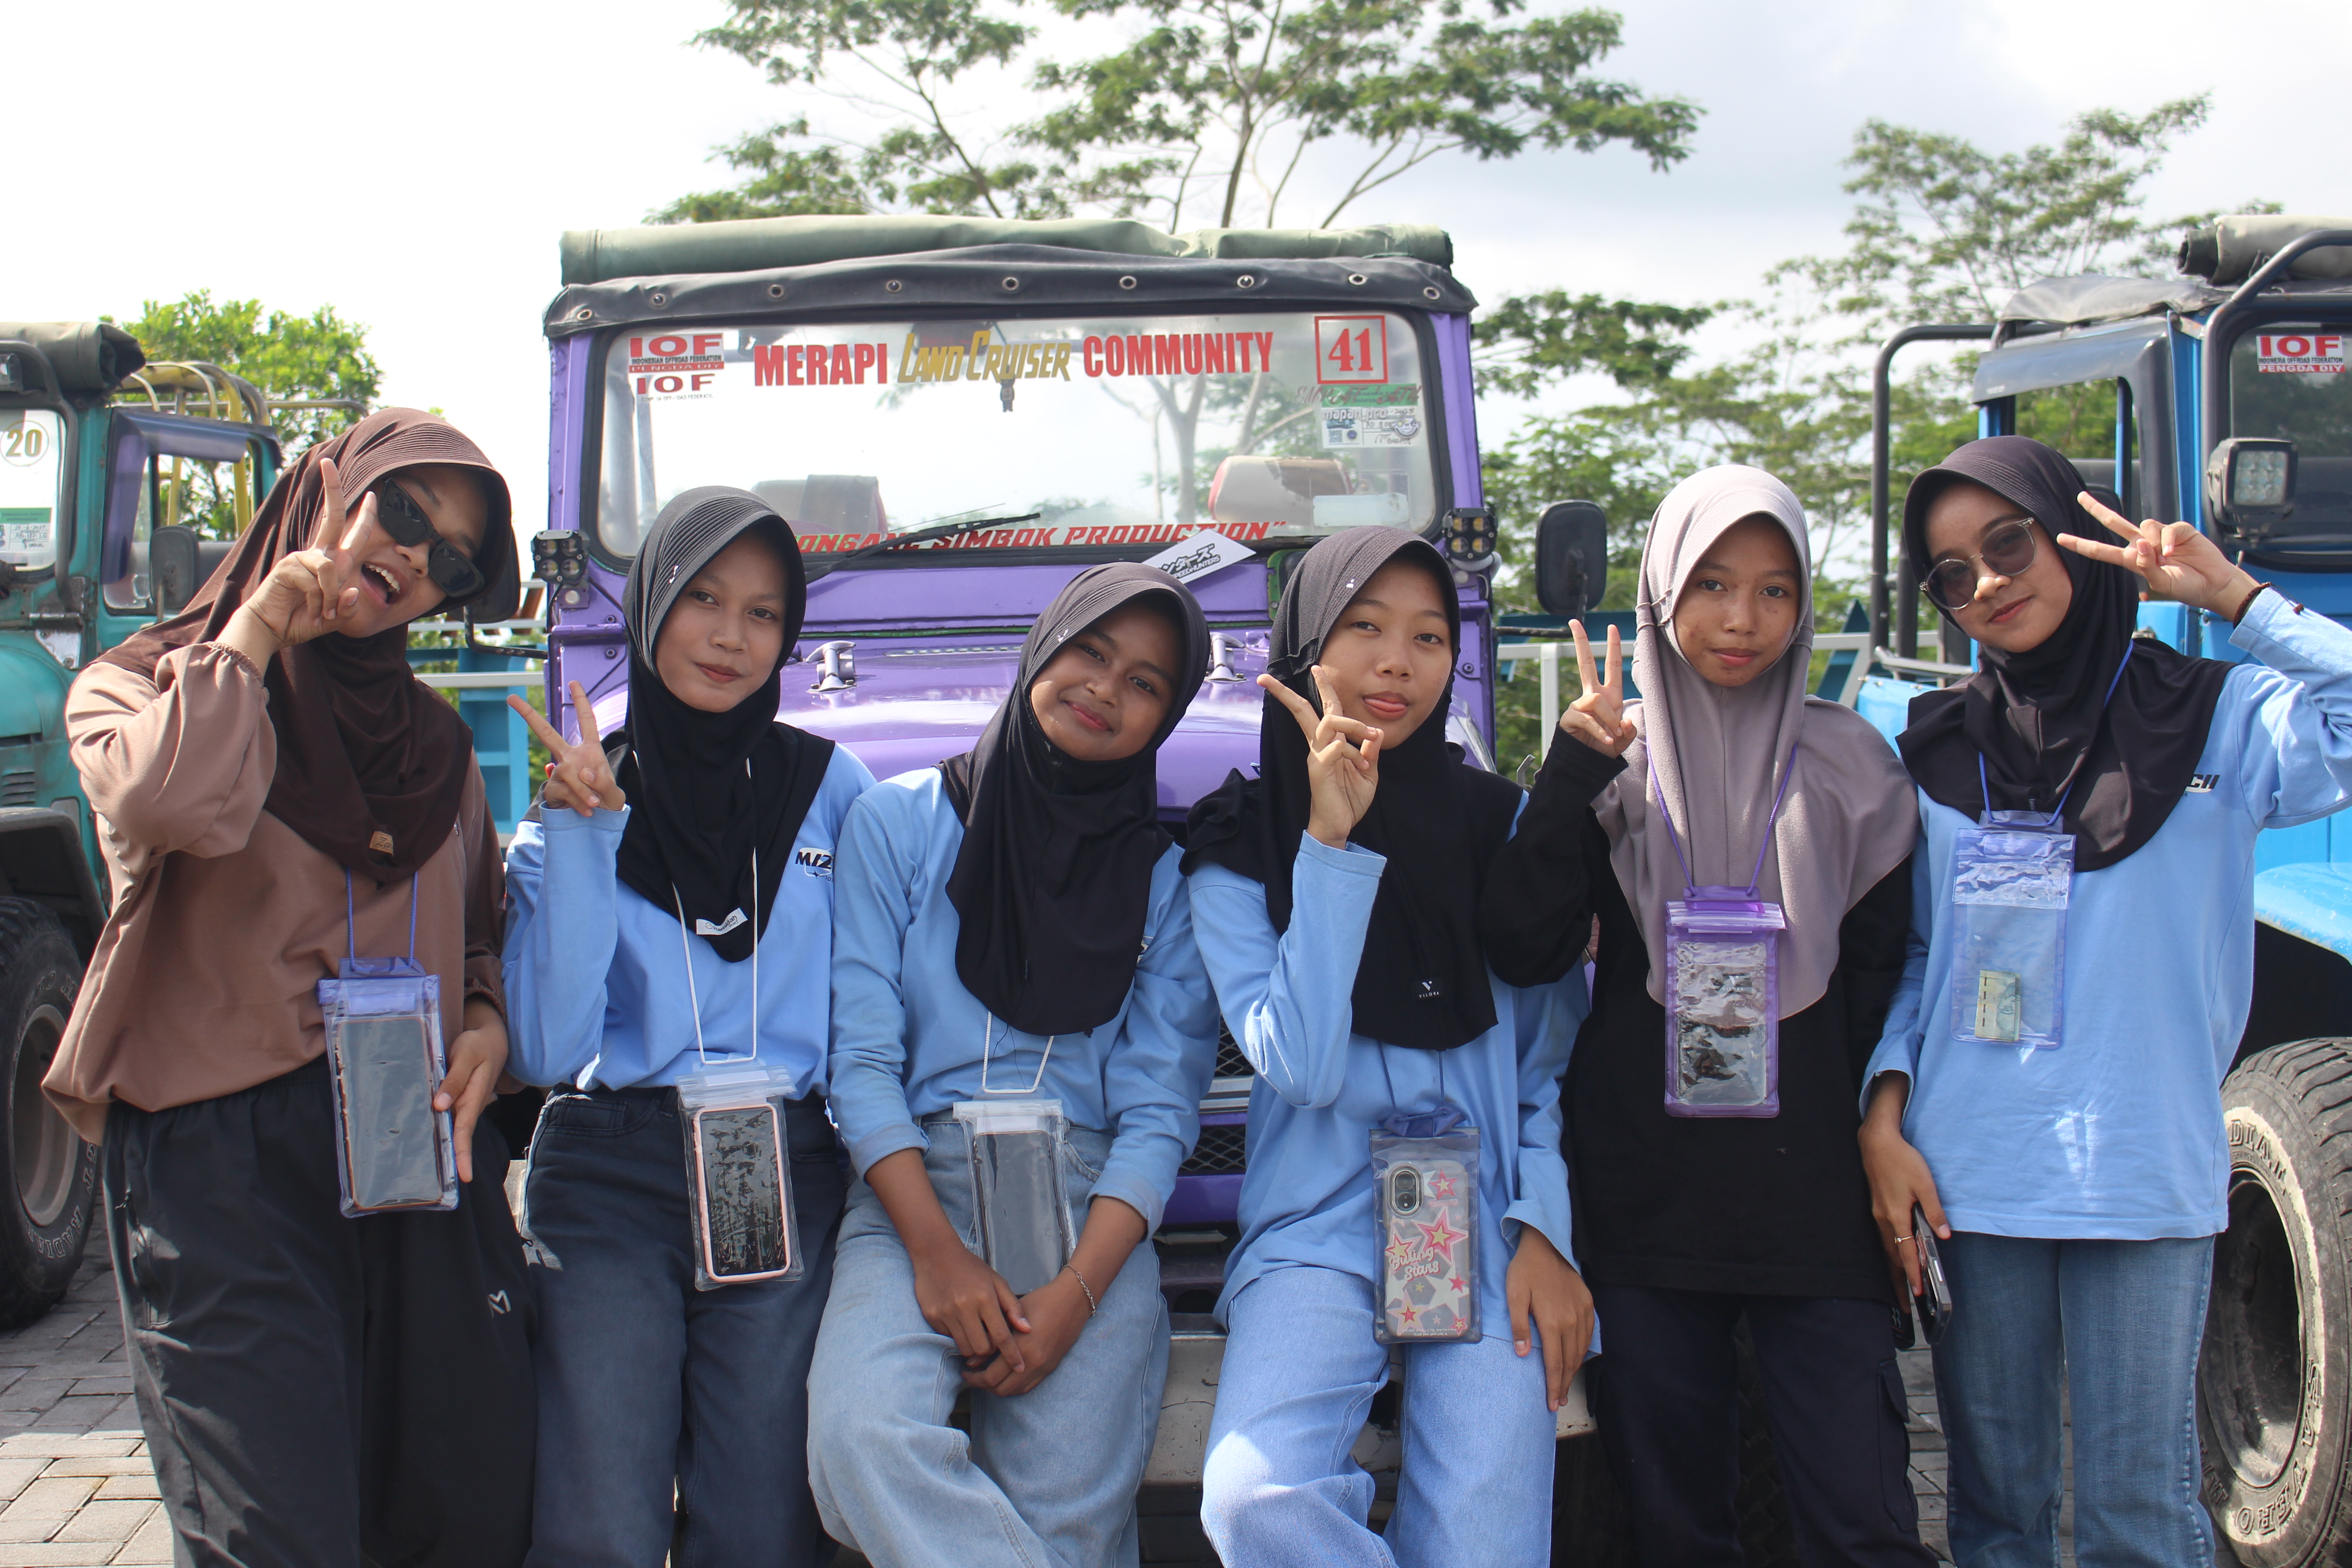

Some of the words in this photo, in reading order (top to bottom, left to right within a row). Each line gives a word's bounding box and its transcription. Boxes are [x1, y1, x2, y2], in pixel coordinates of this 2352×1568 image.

[630, 334, 722, 358] IOF
[1328, 328, 1373, 371] 41
[2260, 336, 2339, 357] IOF
[754, 343, 887, 386] MERAPI
[1083, 332, 1274, 377] COMMUNITY
[637, 373, 715, 395] IOF
[5, 429, 42, 457] 20
[713, 915, 737, 931] Hamidah
[1404, 1260, 1441, 1282] Stars
